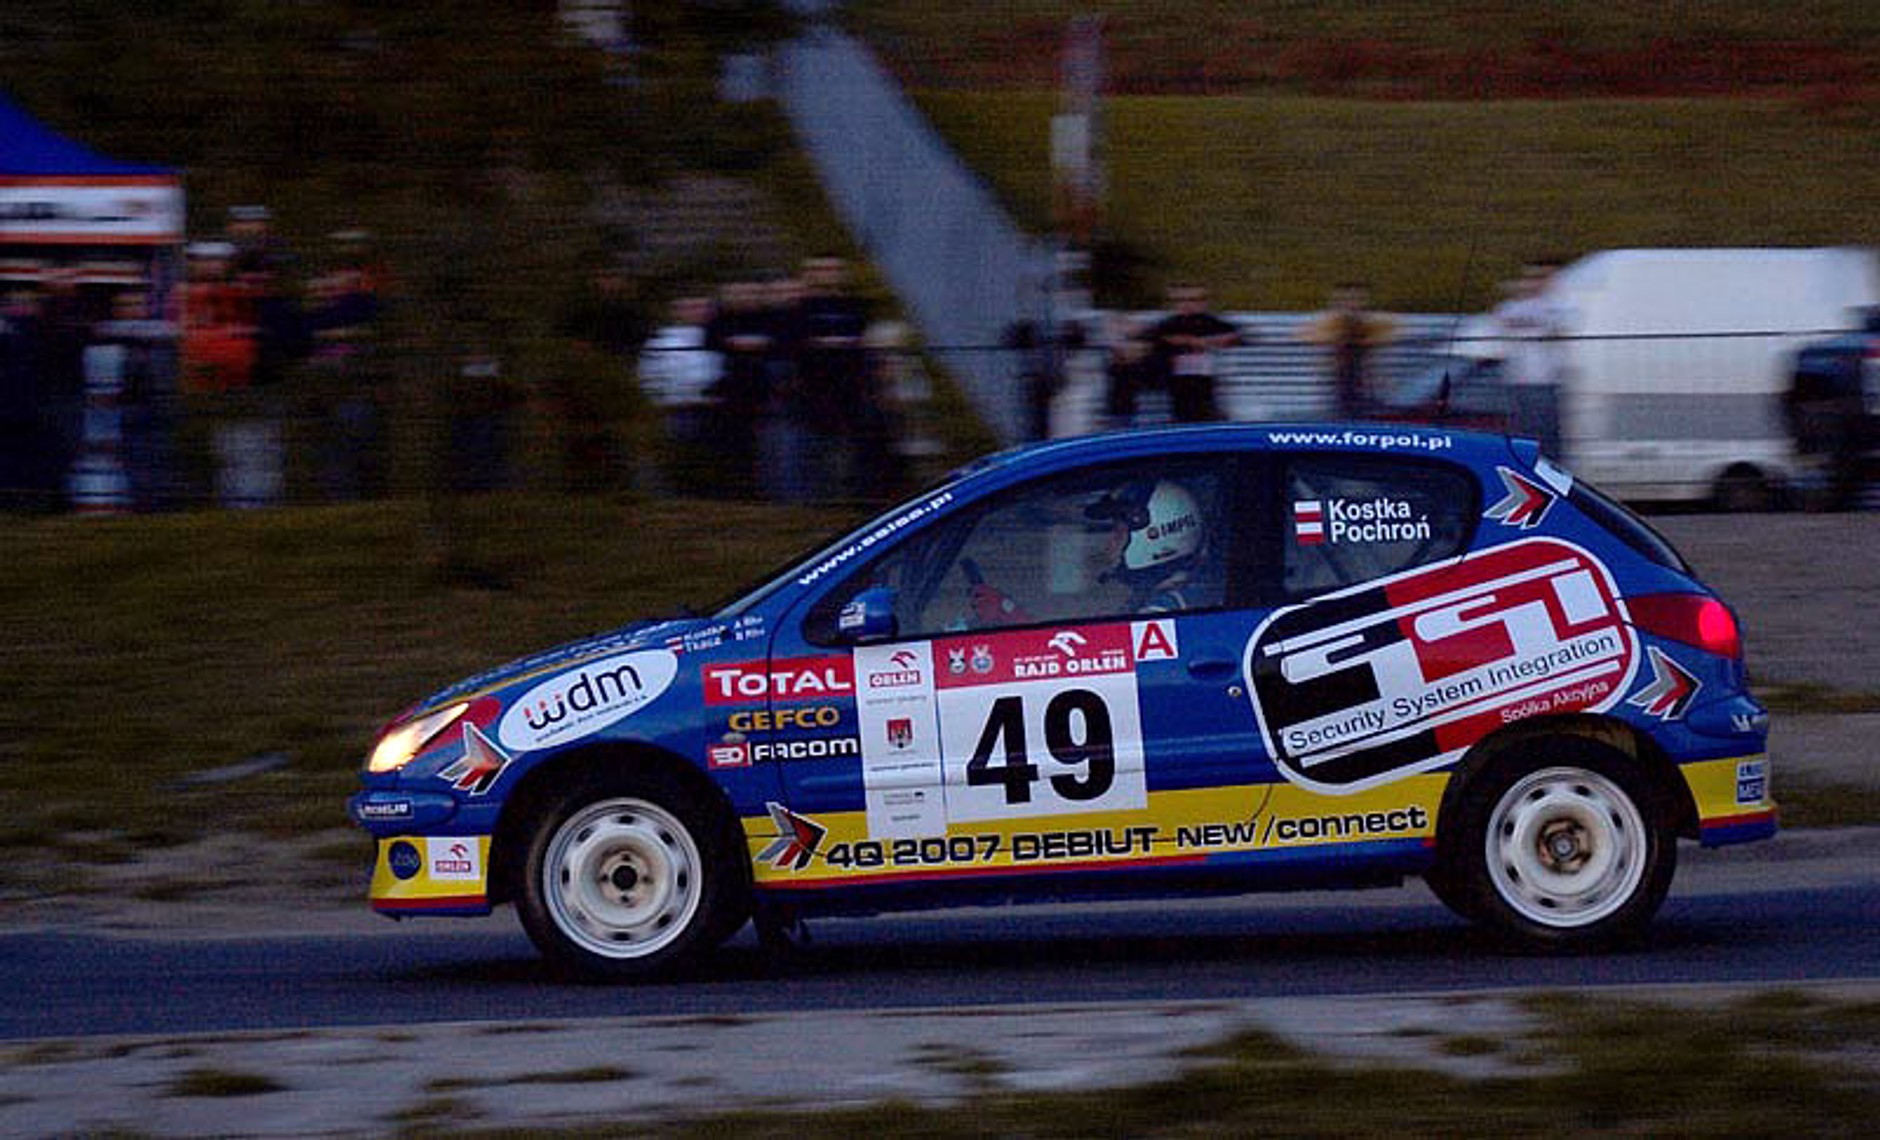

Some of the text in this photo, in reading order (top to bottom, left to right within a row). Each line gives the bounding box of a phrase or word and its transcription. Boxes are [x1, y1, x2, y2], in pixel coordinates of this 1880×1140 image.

[1269, 431, 1452, 449] www.forpol.pl
[1329, 499, 1411, 521] Kostka
[1330, 515, 1430, 543] Pochroń
[1137, 622, 1174, 659] A
[871, 671, 919, 687] ORLEN
[1014, 660, 1060, 678] RAJD
[1066, 654, 1127, 674] ORLEN
[709, 667, 850, 698] TOTAL
[1288, 634, 1616, 752] Security System Integration
[729, 706, 839, 731] GEFCO
[967, 689, 1116, 804] 49
[893, 836, 1000, 865] 2007
[1012, 828, 1158, 860] DEBIUT
[1176, 821, 1257, 848] NEW
